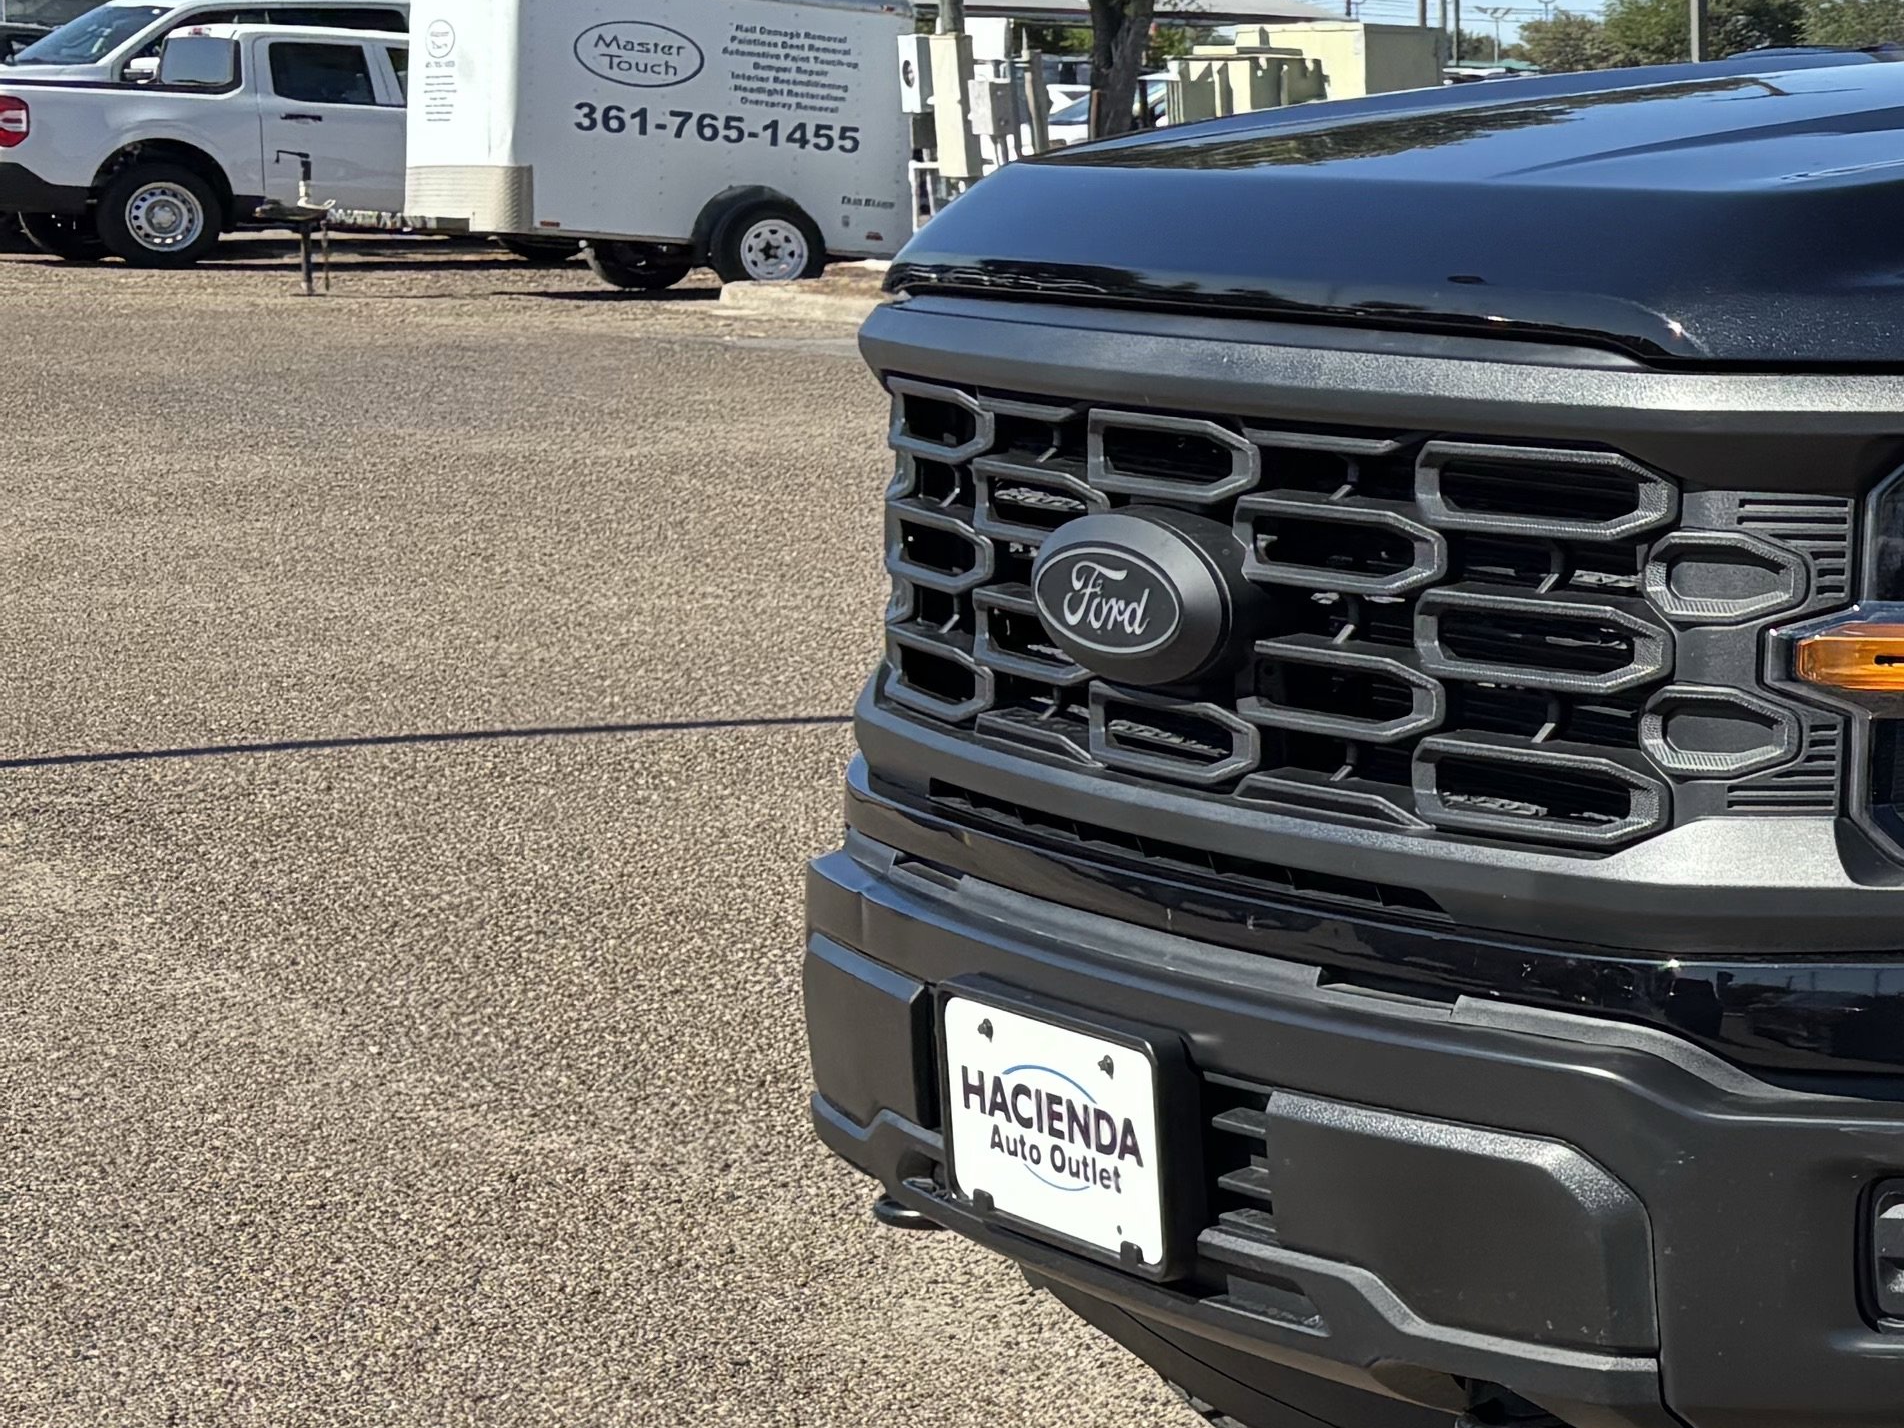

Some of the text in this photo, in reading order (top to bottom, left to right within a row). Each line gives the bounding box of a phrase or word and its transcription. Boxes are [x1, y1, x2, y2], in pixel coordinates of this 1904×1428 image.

[593, 33, 686, 57] Master
[600, 53, 678, 76] Touch
[574, 101, 860, 154] 361-765-1455
[1063, 560, 1150, 635] Ford
[961, 1065, 1144, 1167] HACIENDA
[990, 1124, 1122, 1194] Auto Outlet
